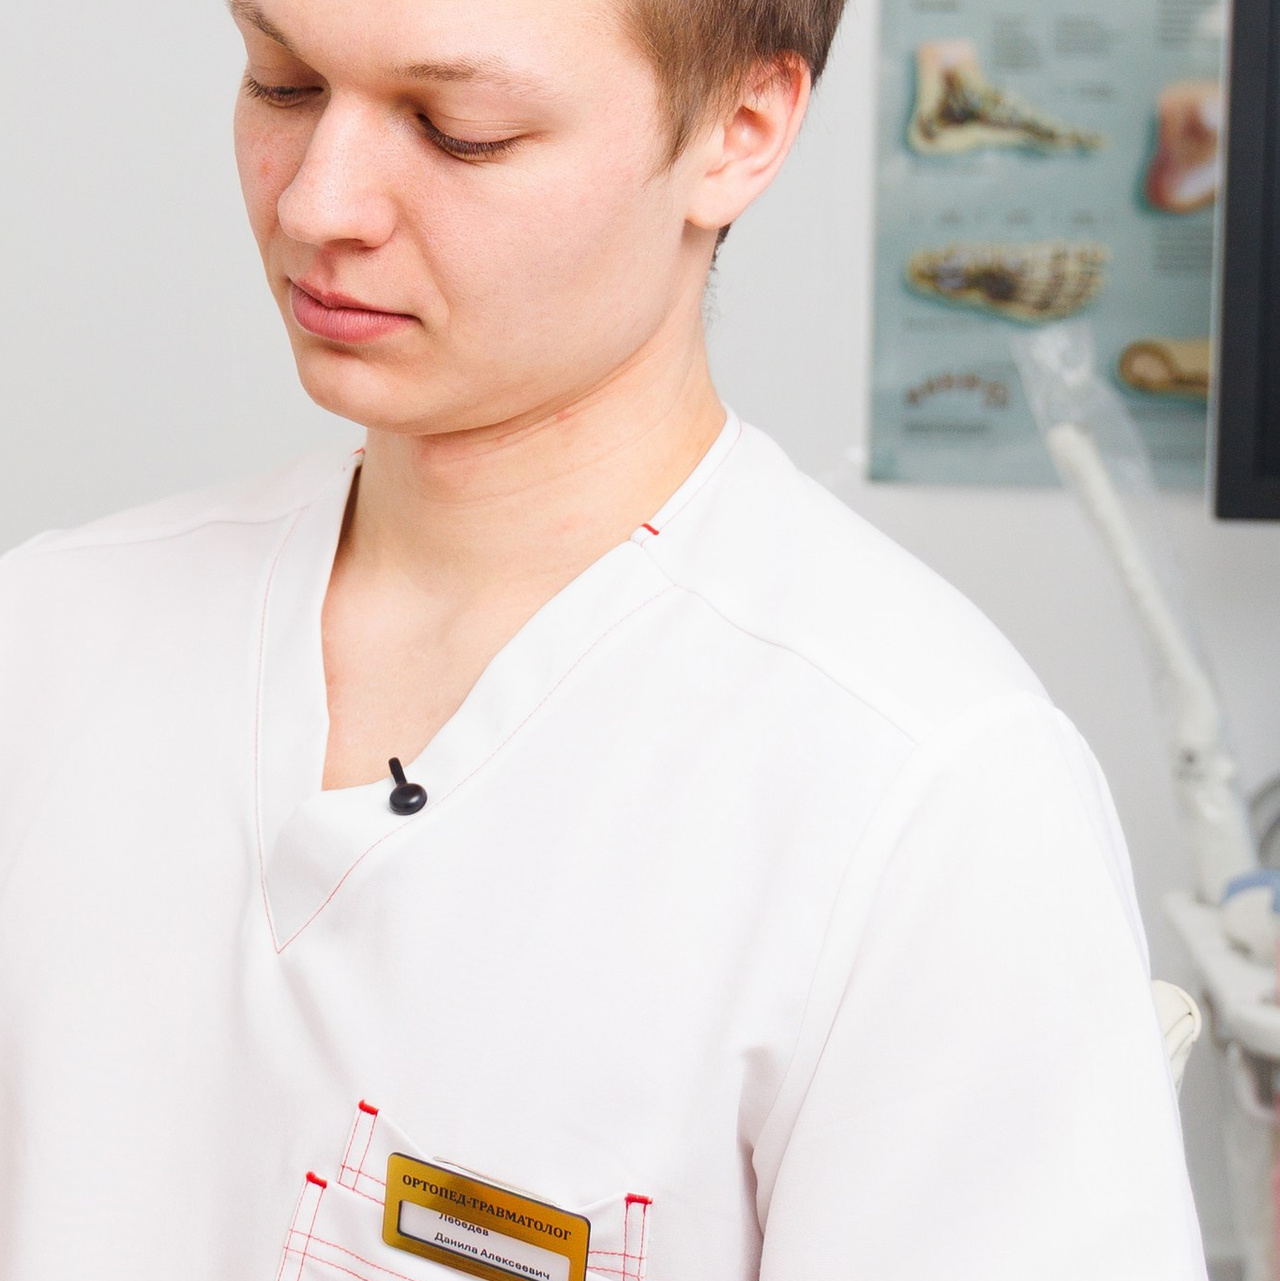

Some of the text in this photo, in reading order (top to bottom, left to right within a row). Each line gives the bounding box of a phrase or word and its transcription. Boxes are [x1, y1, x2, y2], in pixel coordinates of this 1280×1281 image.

[402, 1174, 572, 1241] ОРТОПЕД-ТРАВМАТОЛОГ
[439, 1213, 489, 1237] Лебедев
[434, 1232, 550, 1280] Данила Алексеевич
